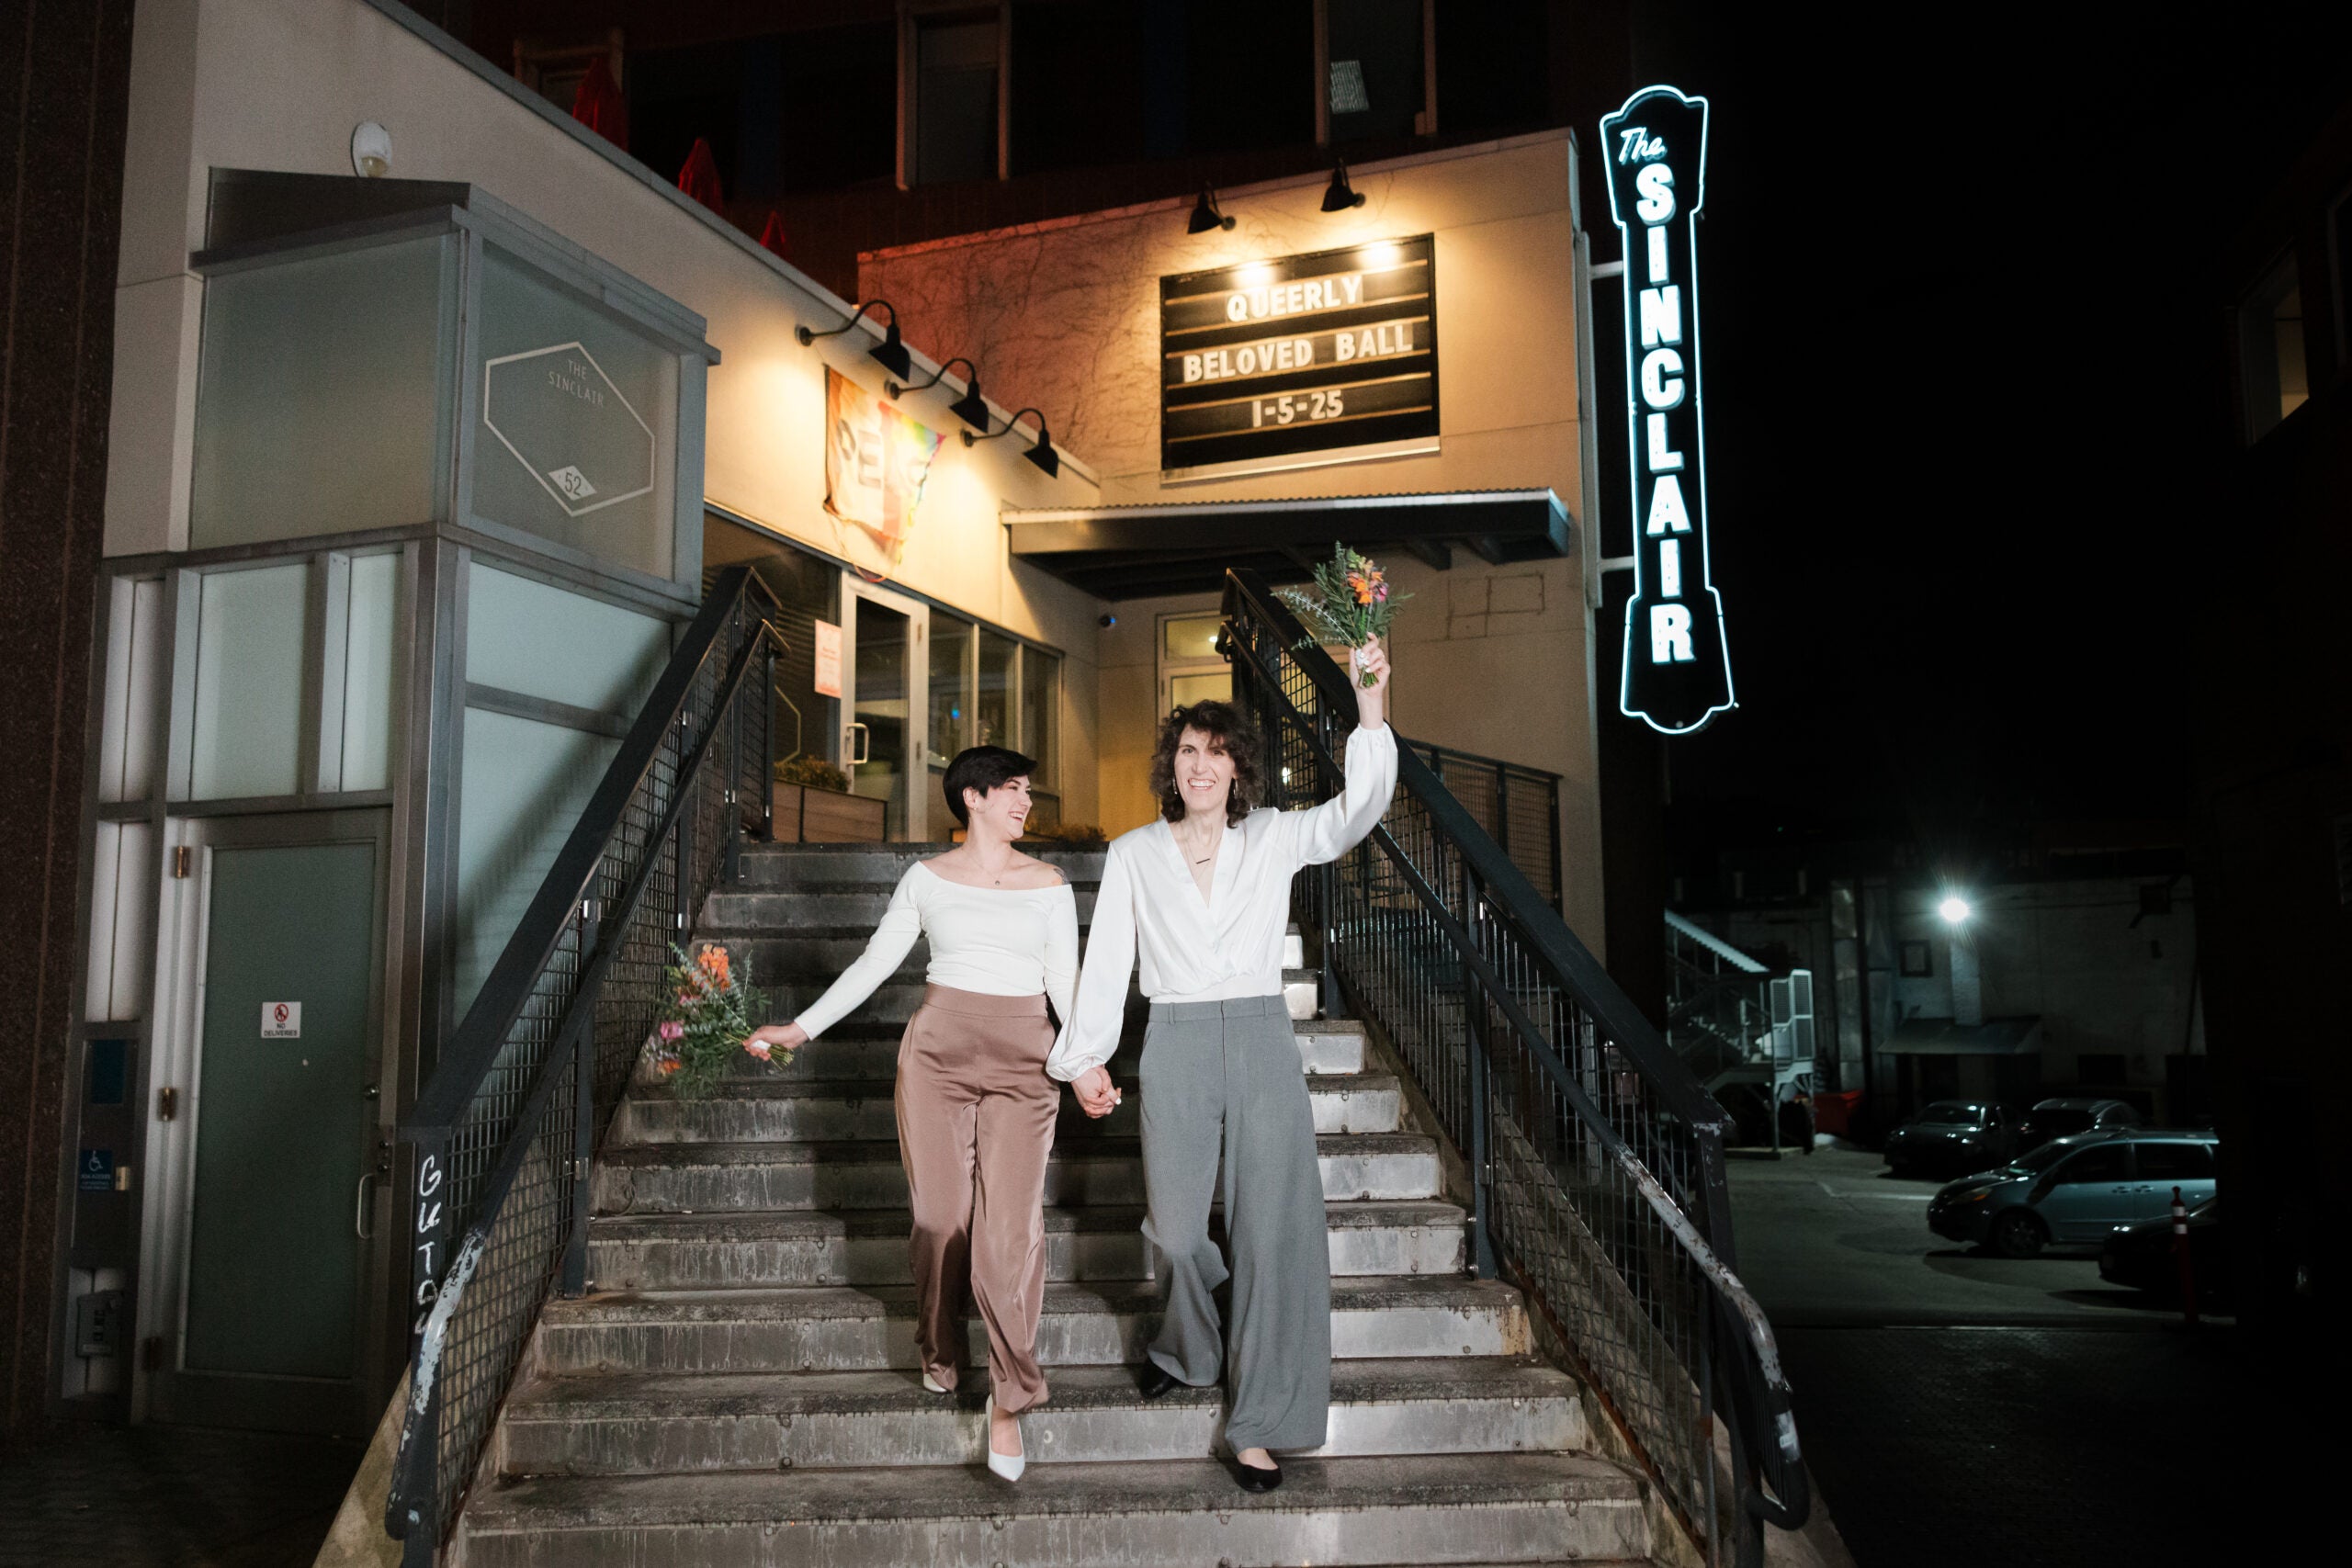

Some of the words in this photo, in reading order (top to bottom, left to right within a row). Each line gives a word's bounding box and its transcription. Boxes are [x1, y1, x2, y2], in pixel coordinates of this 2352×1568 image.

[1619, 127, 1667, 164] The
[1227, 276, 1363, 322] QUEERLY
[567, 359, 587, 380] THE
[1183, 338, 1313, 383] BELOVED
[1336, 325, 1413, 362] BALL
[548, 372, 604, 408] SINCLAIR
[1252, 389, 1344, 428] 1-5-25
[1635, 163, 1696, 663] SINCLAIR
[564, 471, 582, 496] 52
